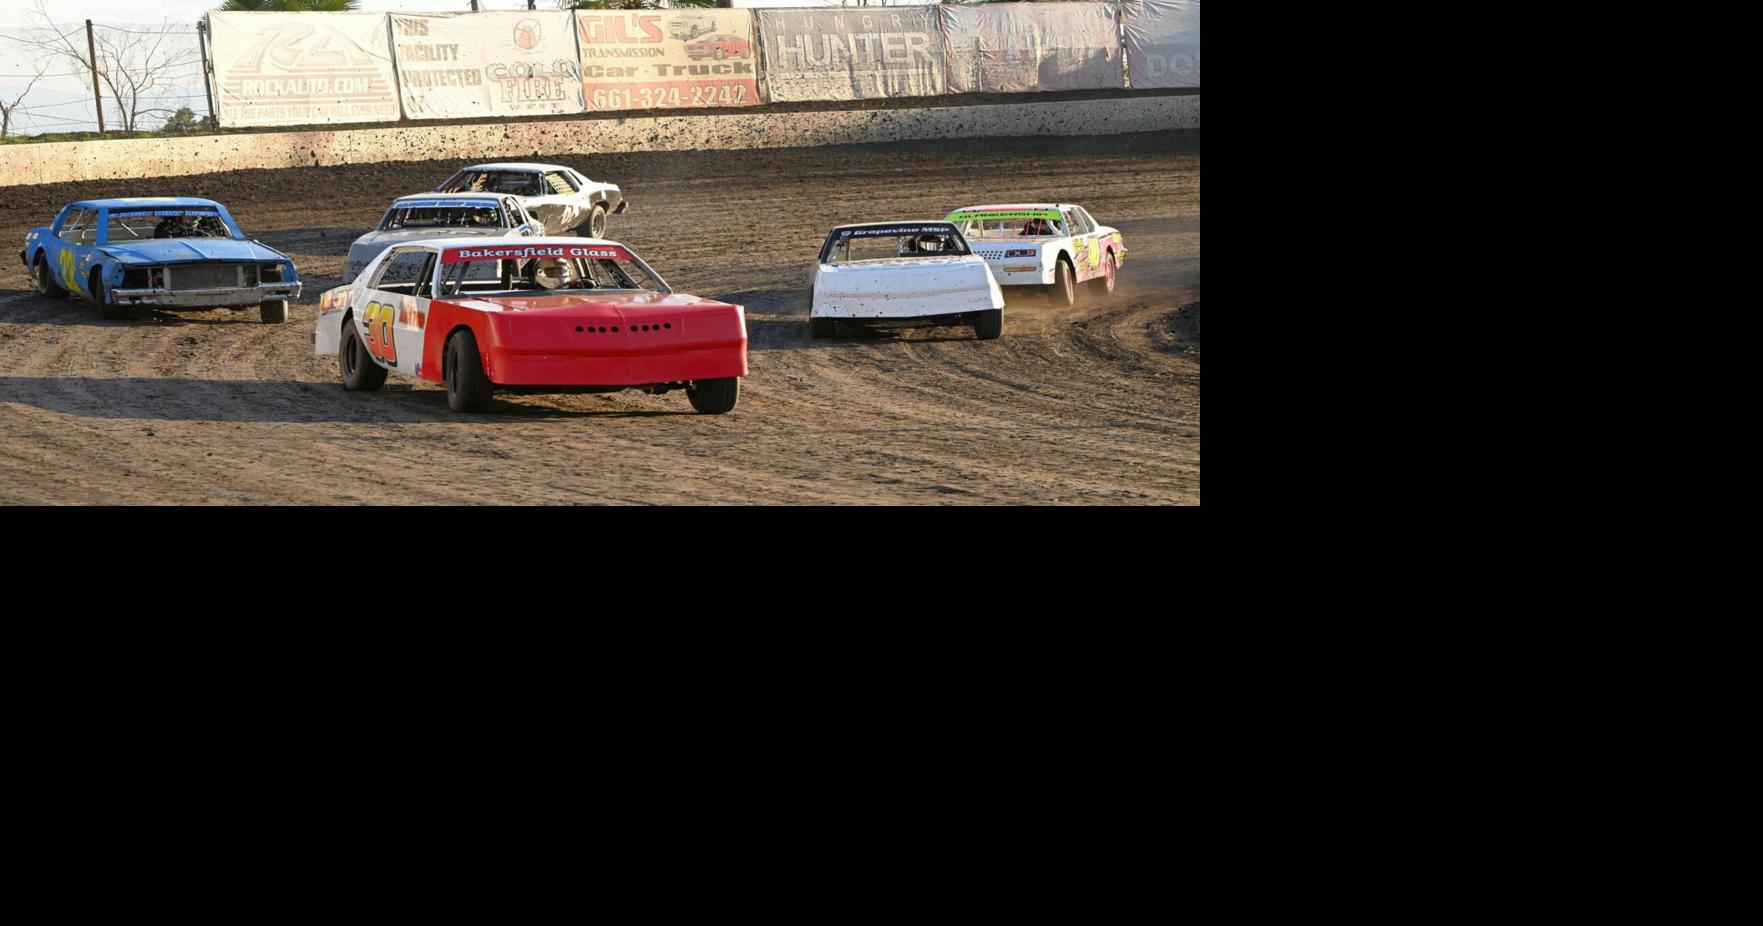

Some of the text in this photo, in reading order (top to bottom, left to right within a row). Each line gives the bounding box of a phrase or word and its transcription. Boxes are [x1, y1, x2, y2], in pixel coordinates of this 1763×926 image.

[579, 14, 664, 44] GIL'S
[775, 12, 930, 30] HUNGRY
[583, 47, 665, 59] TRANSMISSION
[776, 32, 935, 69] HUNTER
[584, 61, 754, 78] Car Truck
[242, 77, 369, 96] ROCKAUTO.COM
[499, 77, 566, 102] FIRE
[593, 85, 747, 110] 661-324-2242
[853, 227, 920, 236] Grapevine
[459, 247, 617, 258] Bakersfield Glass
